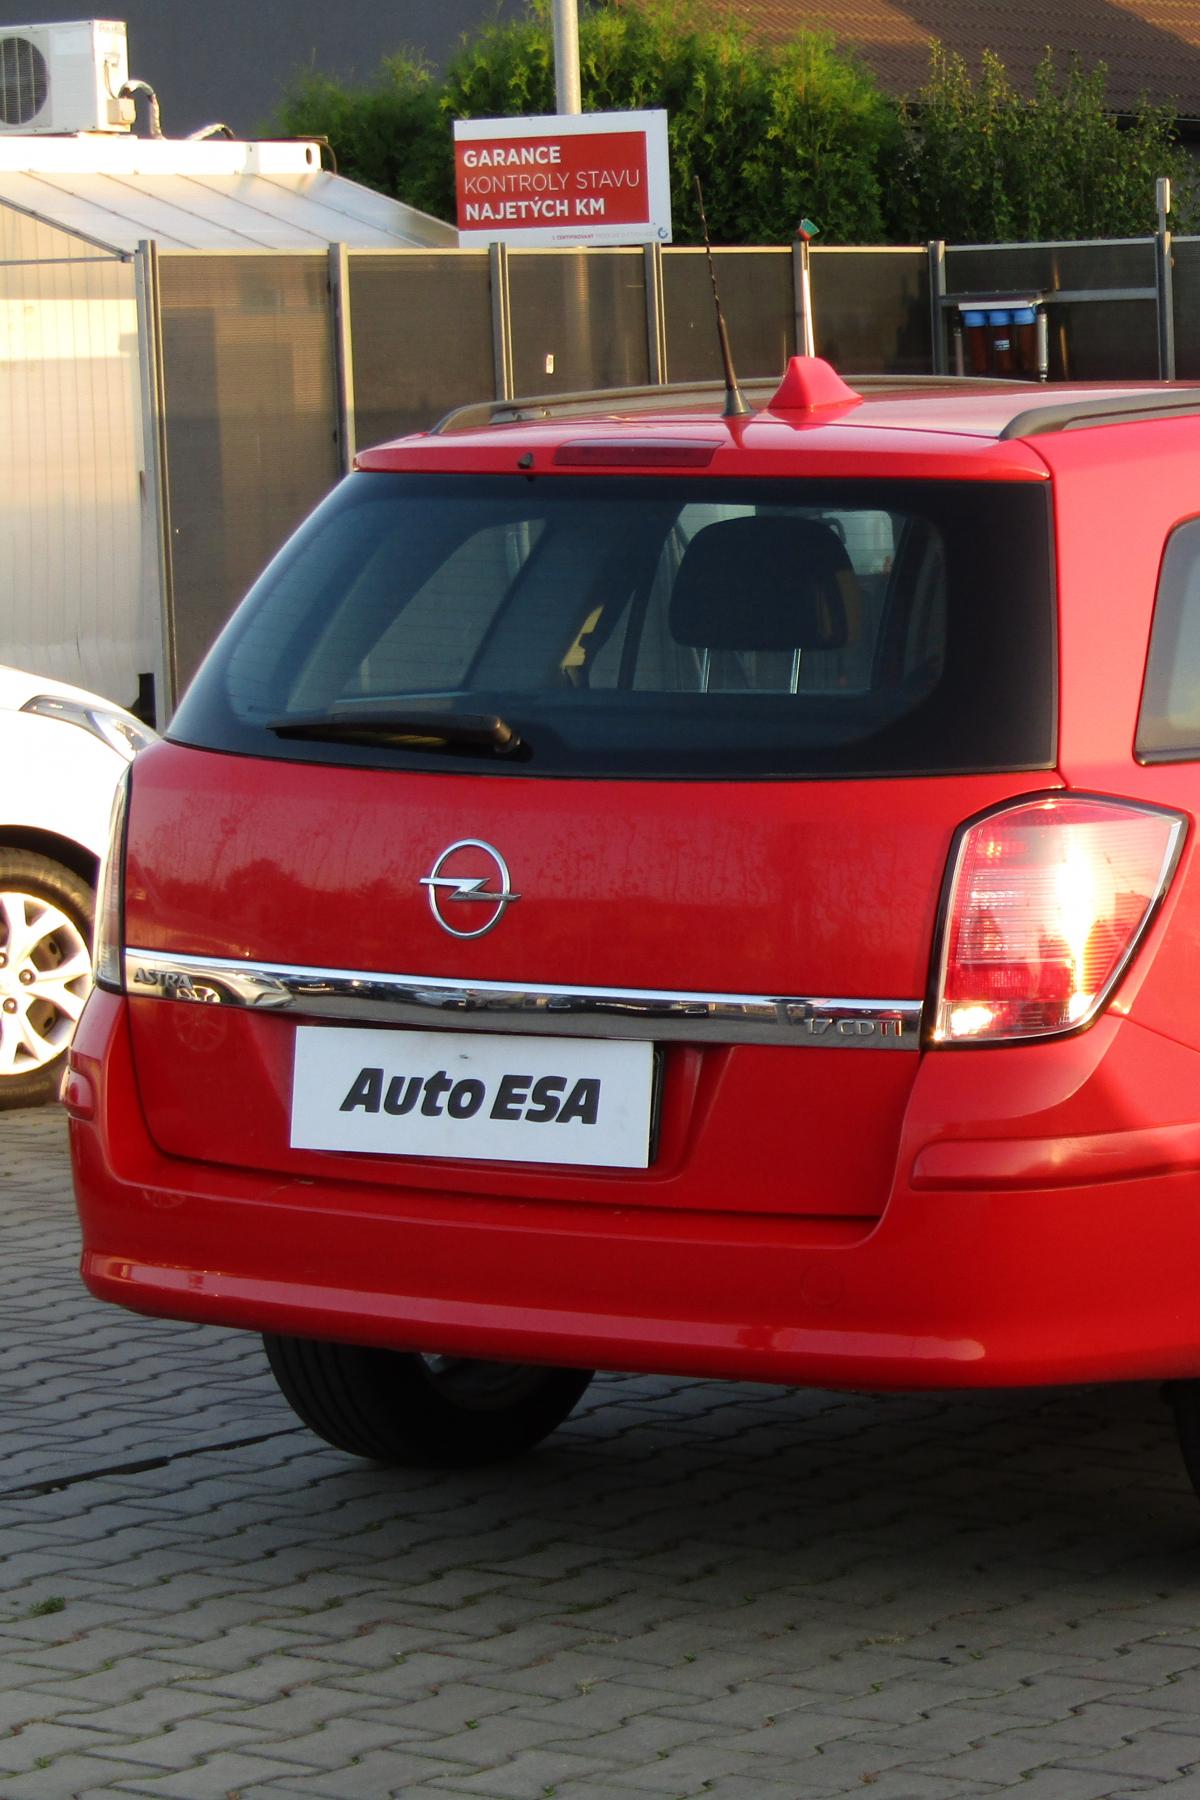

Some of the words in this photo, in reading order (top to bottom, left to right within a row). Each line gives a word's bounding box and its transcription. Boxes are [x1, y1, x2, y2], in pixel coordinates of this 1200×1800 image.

[463, 146, 561, 168] GARANCE
[464, 172, 570, 195] KONTROLY
[576, 169, 640, 190] STAVU
[465, 196, 569, 221] NAJETÝCH
[575, 198, 605, 216] KM
[133, 967, 193, 990] ASTRA
[836, 1018, 902, 1037] CDTI
[339, 1067, 486, 1119] Auto
[489, 1074, 602, 1125] ESA
